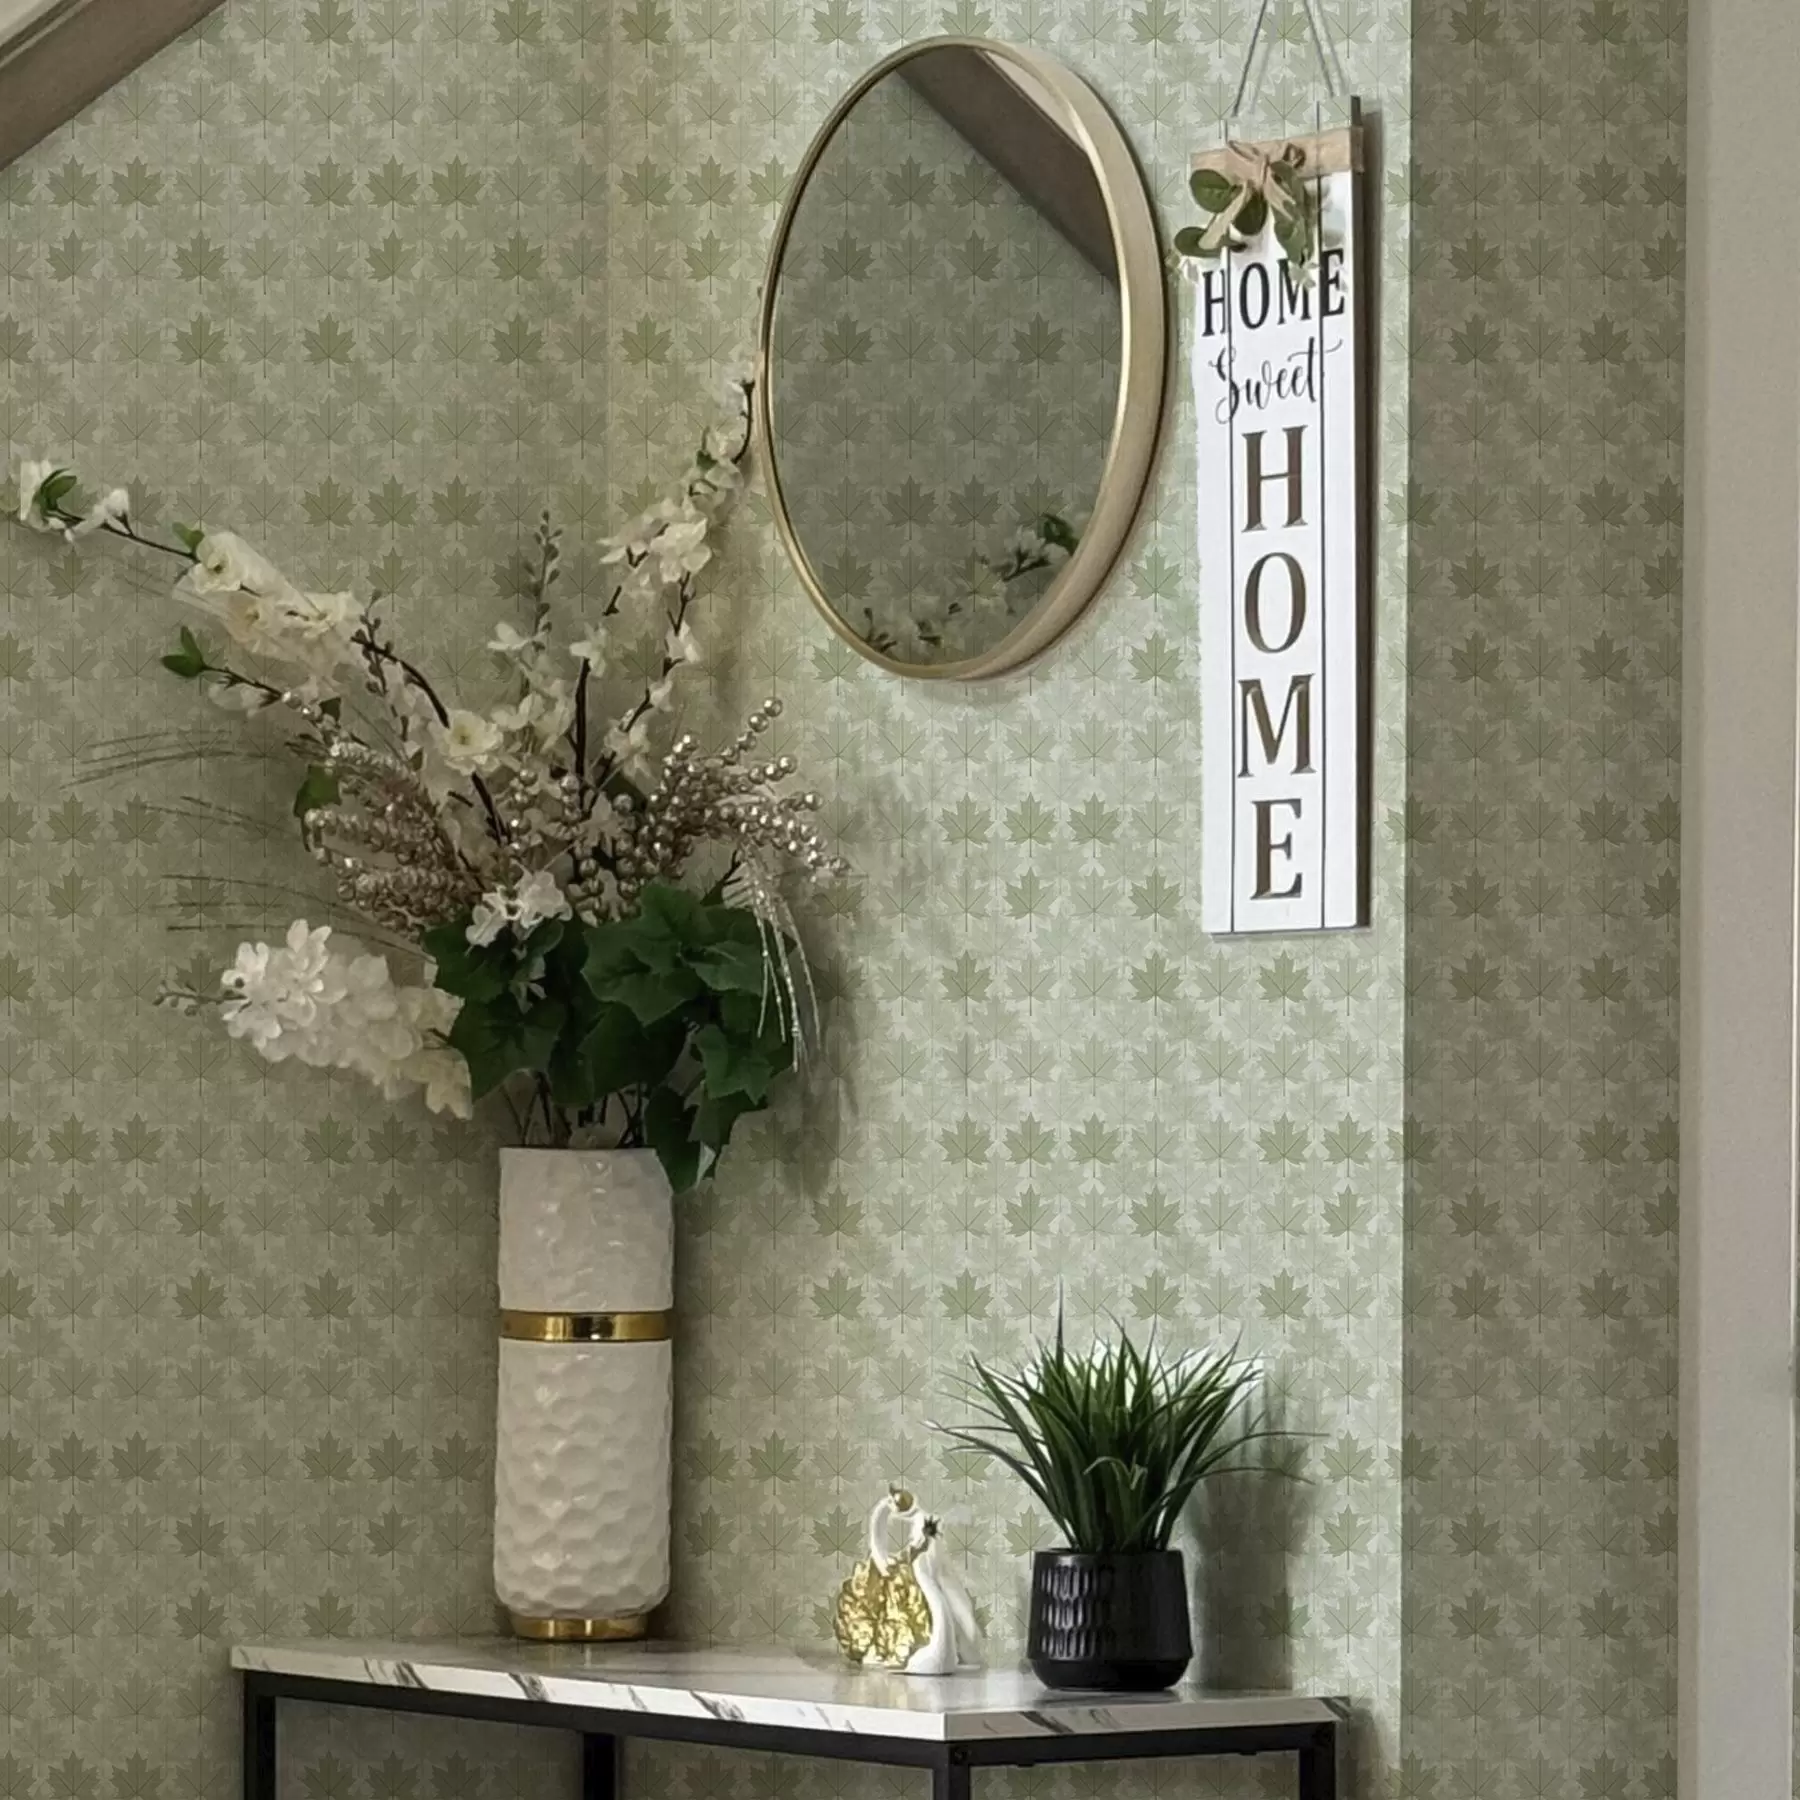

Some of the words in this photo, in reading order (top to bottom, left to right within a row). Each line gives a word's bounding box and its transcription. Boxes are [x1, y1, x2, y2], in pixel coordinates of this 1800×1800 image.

[1202, 248, 1345, 337] HOME
[1208, 336, 1343, 424] Sweet
[1237, 425, 1316, 900] HOME
